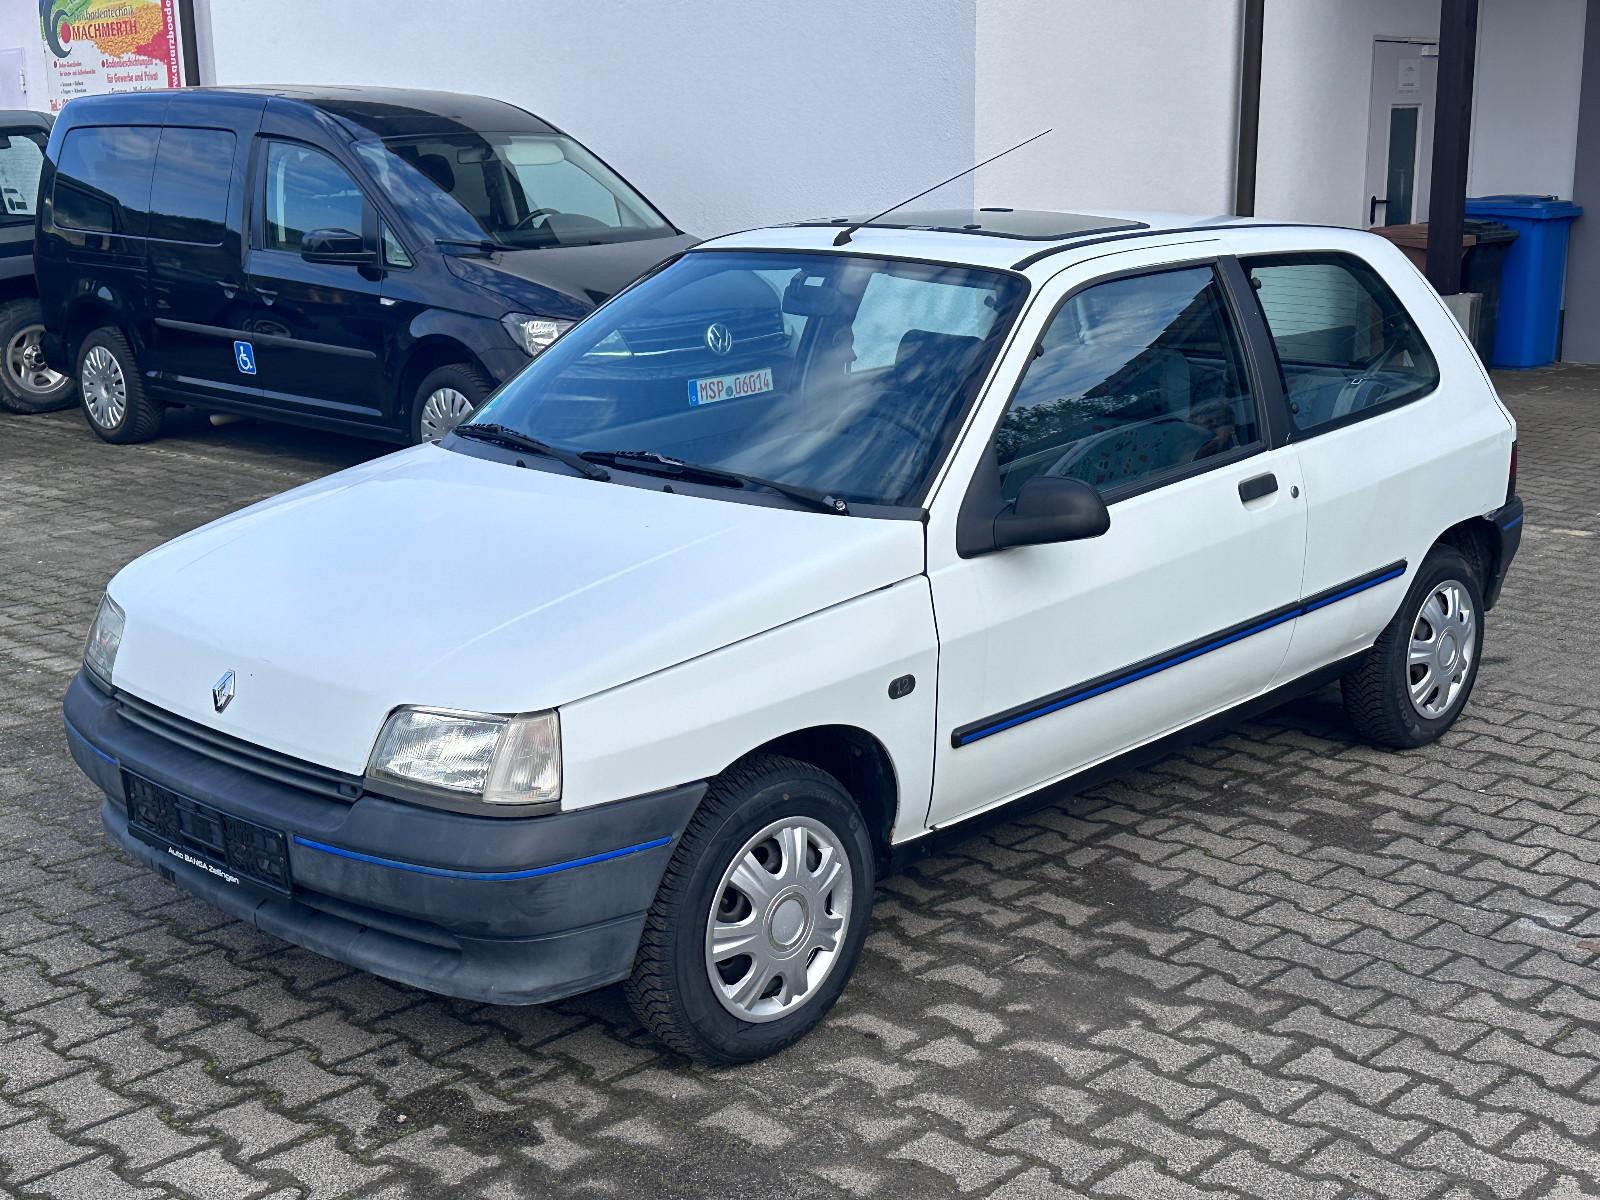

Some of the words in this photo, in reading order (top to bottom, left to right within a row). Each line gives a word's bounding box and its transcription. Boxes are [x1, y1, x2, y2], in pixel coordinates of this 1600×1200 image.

[71, 19, 137, 40] MACHMERTH
[700, 380, 724, 400] MSP
[734, 372, 769, 394] 06014
